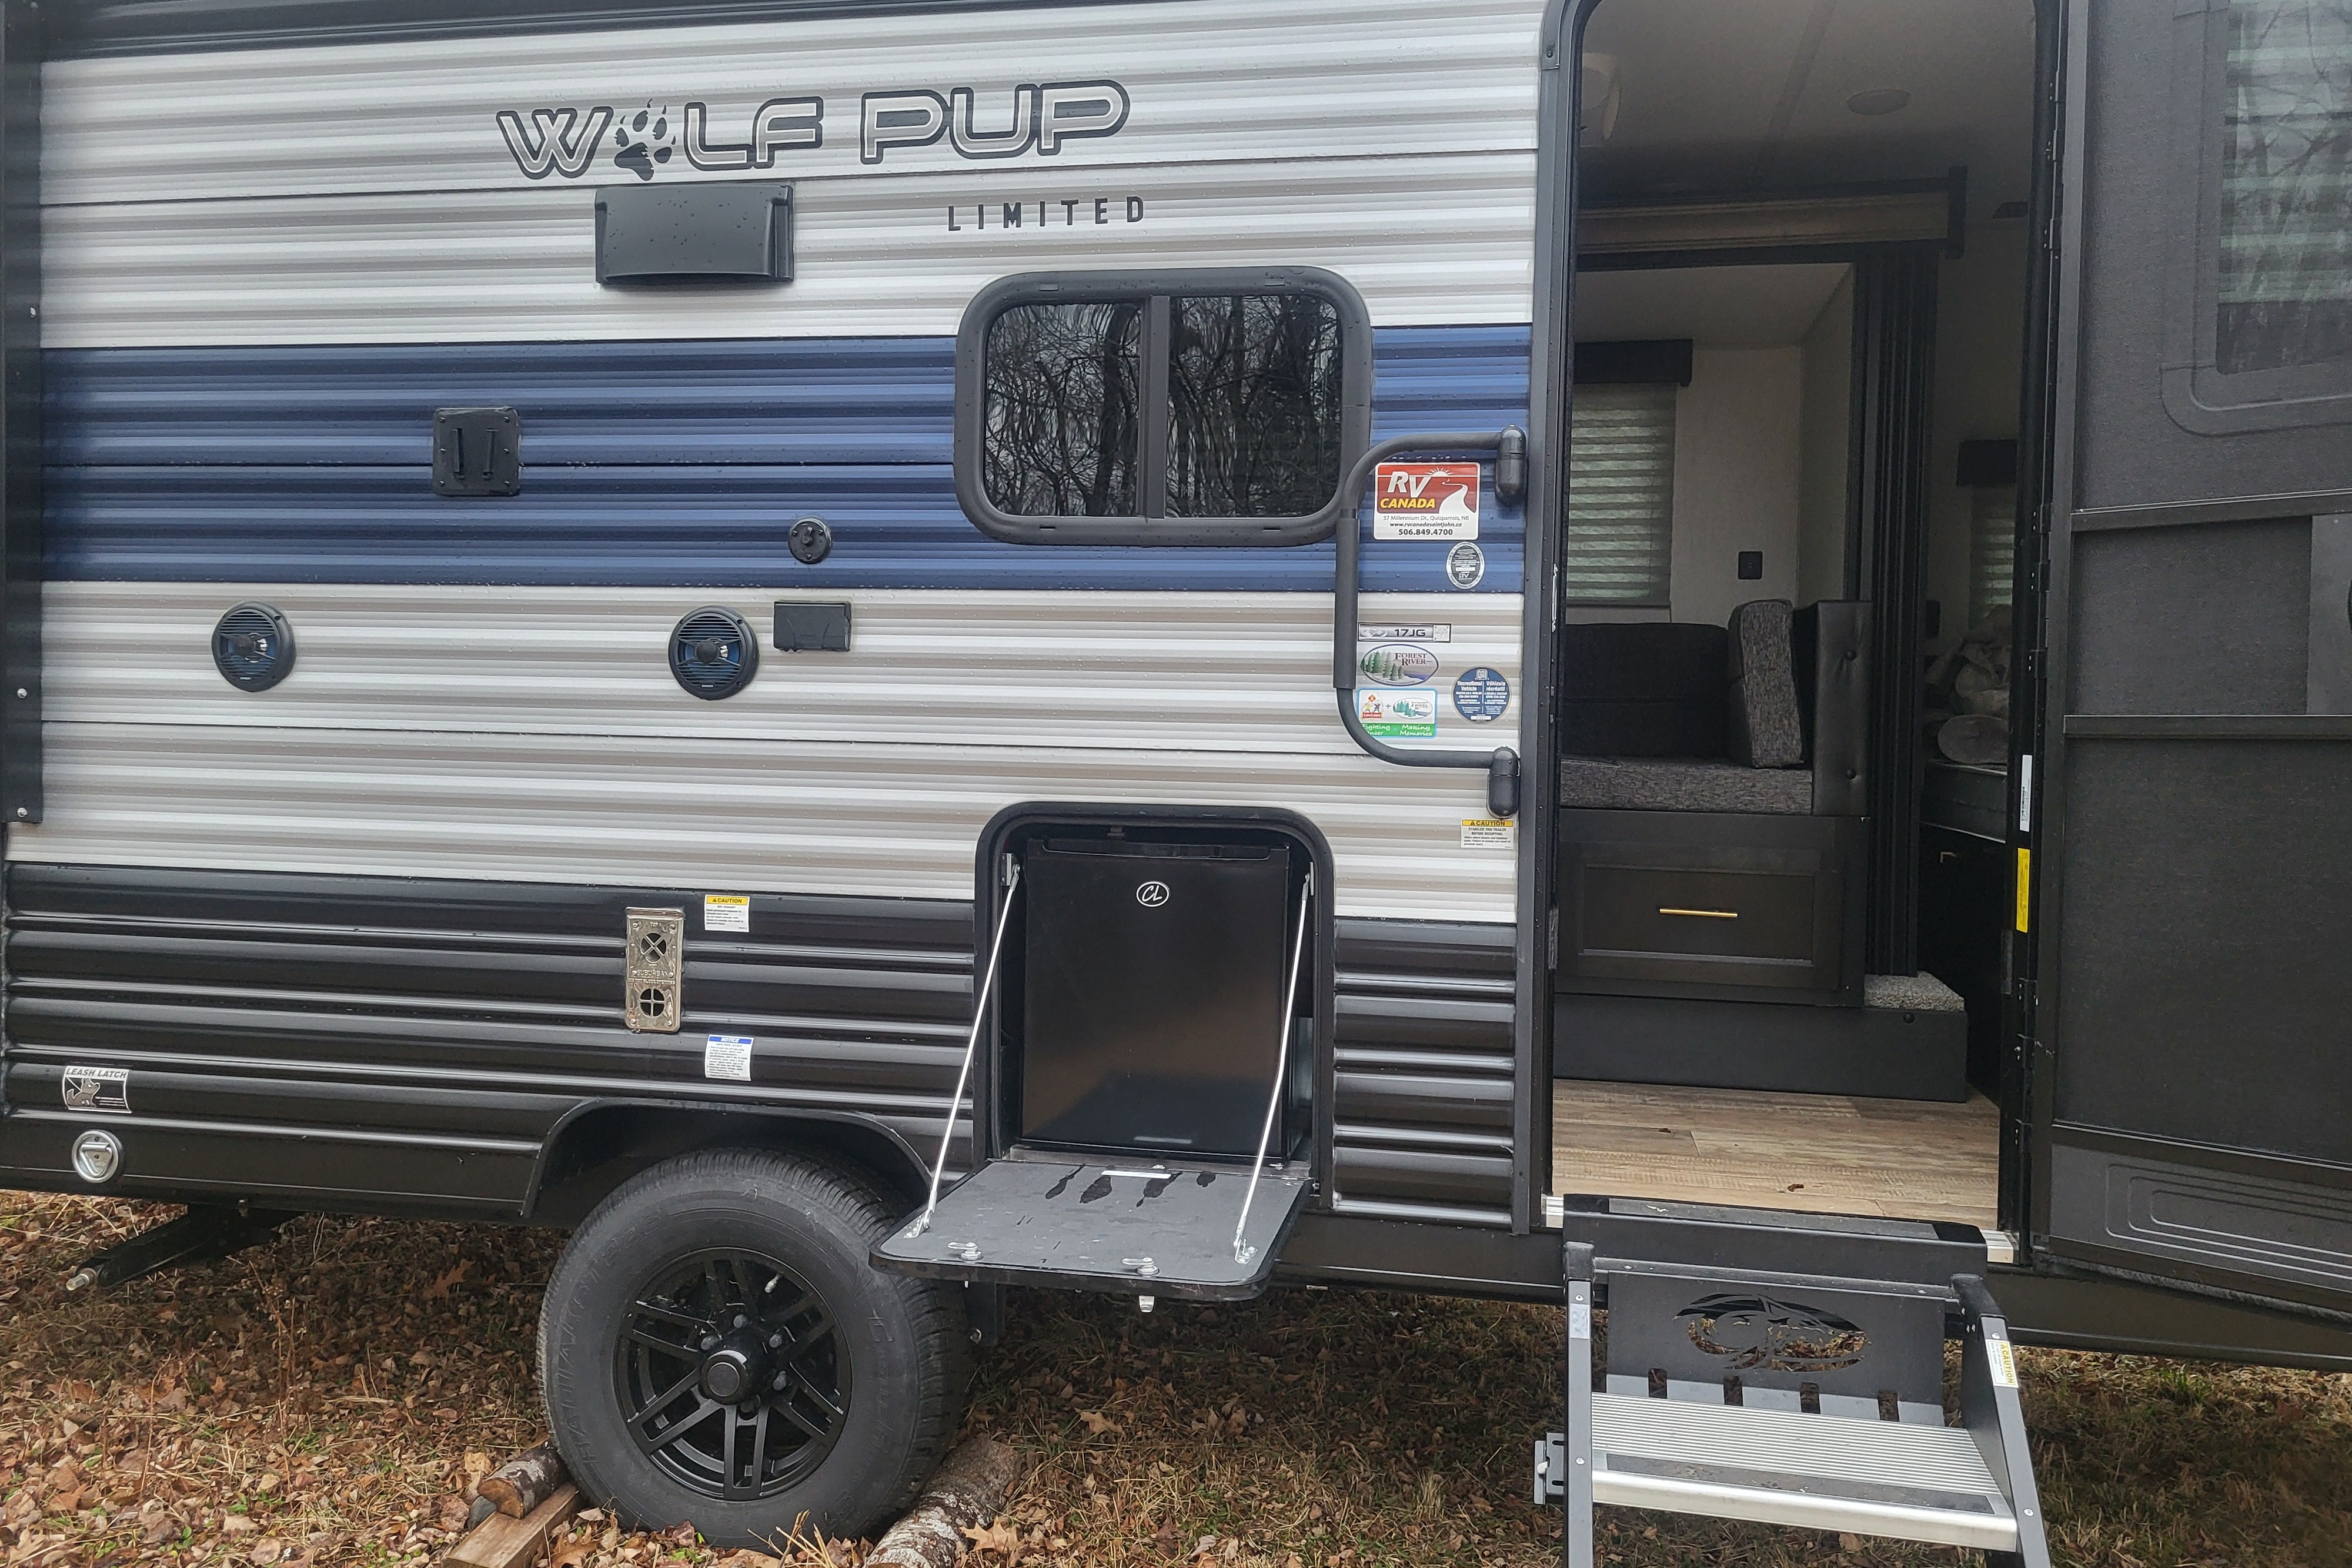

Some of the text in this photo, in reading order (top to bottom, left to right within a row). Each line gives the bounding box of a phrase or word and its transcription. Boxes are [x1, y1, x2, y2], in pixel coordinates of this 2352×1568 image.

[859, 79, 1130, 165] PUP
[947, 195, 1145, 232] LIMITED
[1387, 471, 1432, 498] RV
[1380, 498, 1436, 509] CANADA
[66, 1068, 127, 1078] LEASH LATCH
[2002, 1350, 2014, 1383] CAUTION
